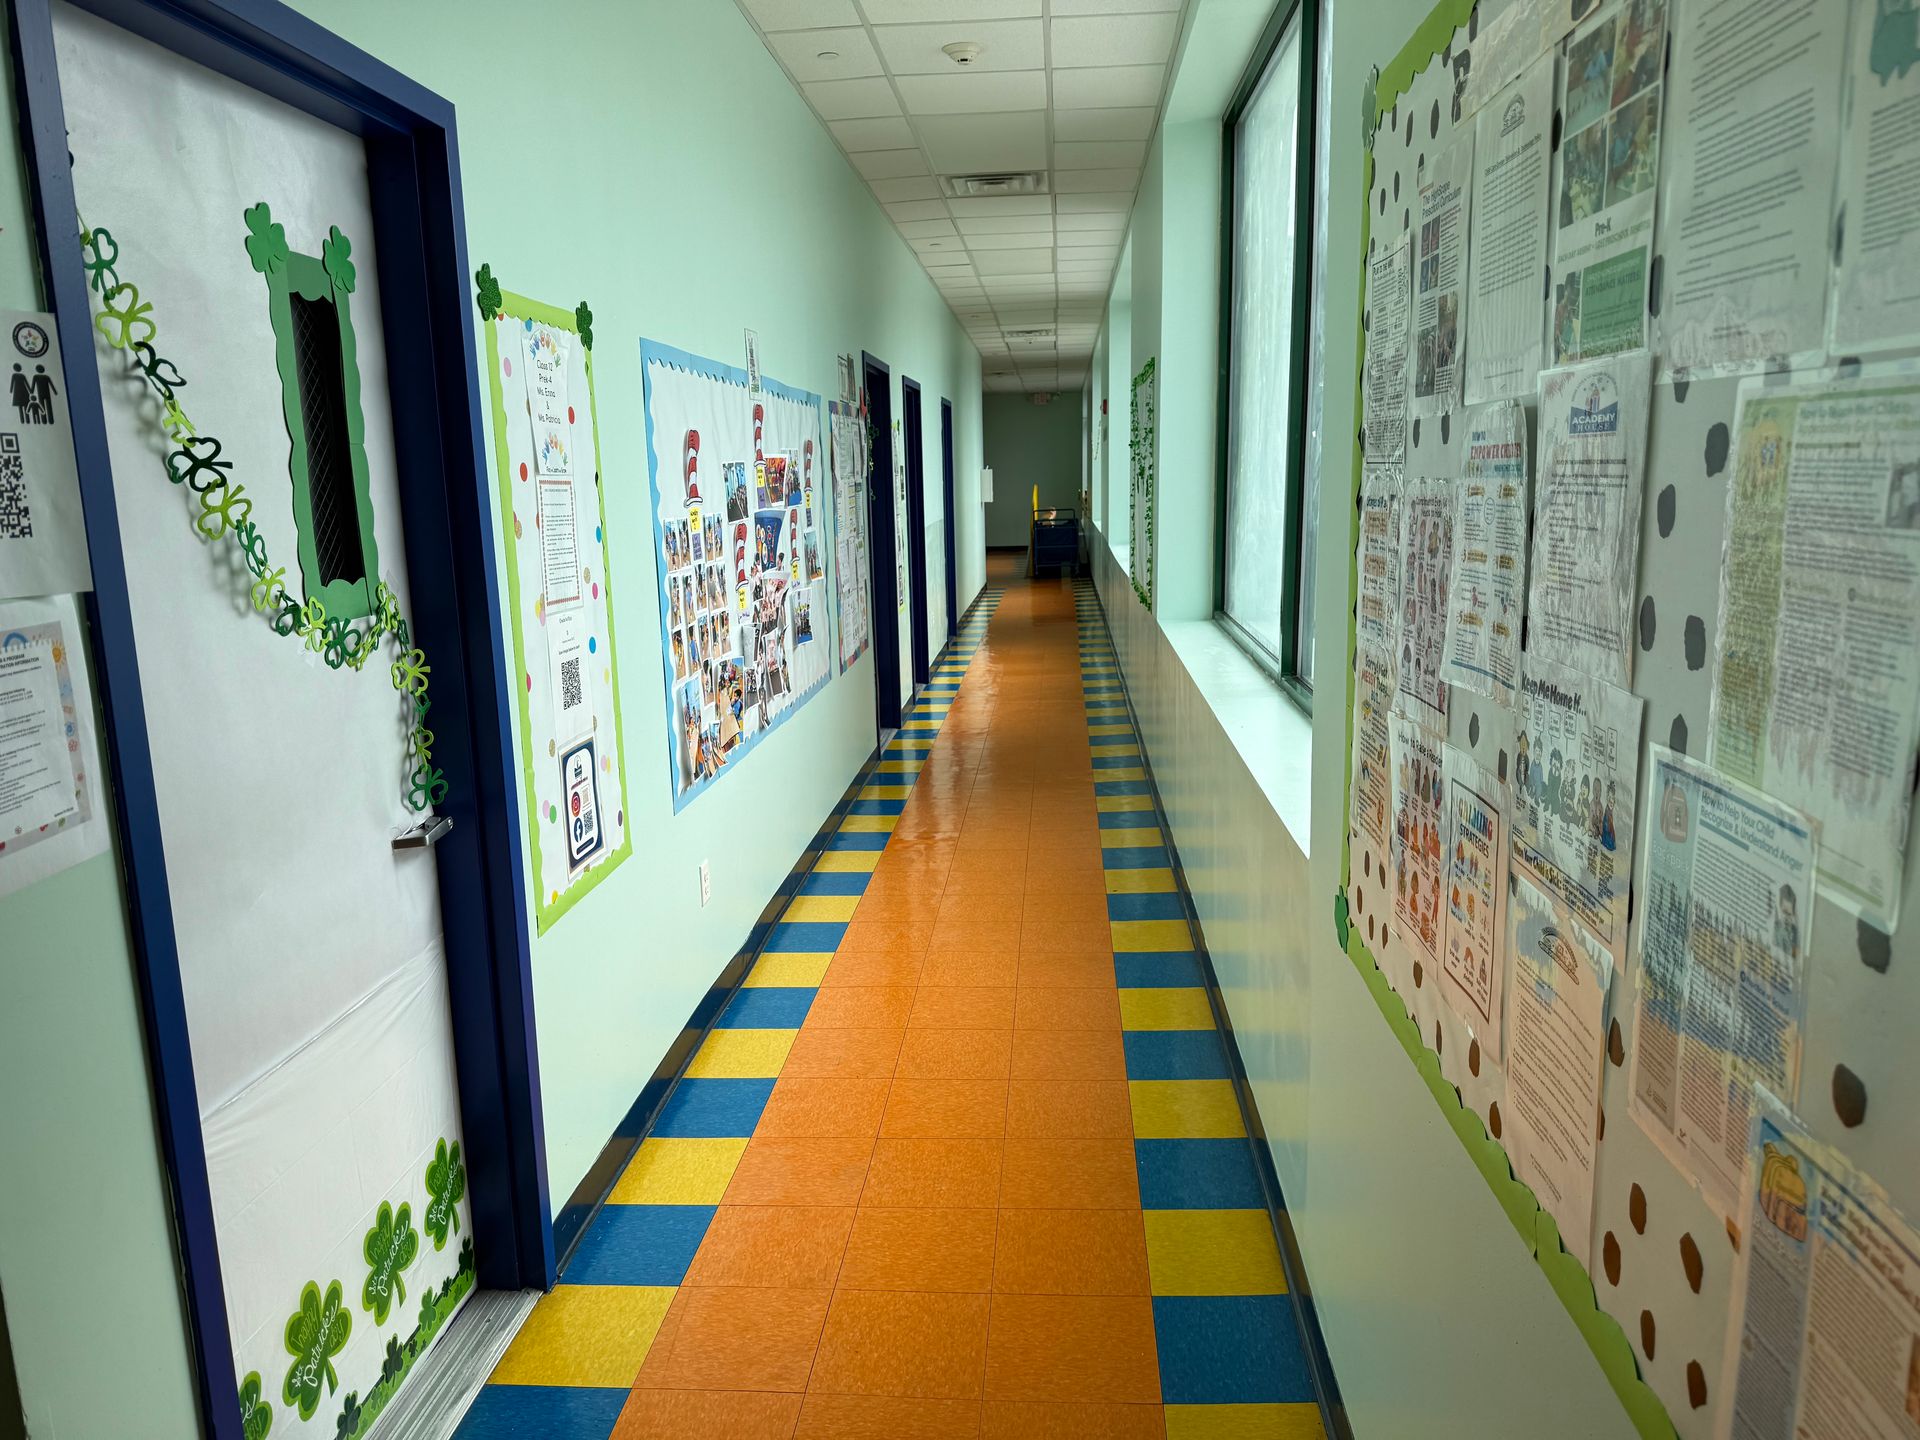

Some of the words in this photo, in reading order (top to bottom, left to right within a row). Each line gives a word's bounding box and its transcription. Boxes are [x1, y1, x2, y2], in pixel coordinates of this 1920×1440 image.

[1572, 413, 1616, 425] ACADEMY
[1522, 671, 1538, 702] Keep
[1538, 679, 1549, 700] Me
[1550, 684, 1573, 710] Home
[1398, 729, 1409, 745] How
[1701, 790, 1716, 808] How
[1717, 801, 1724, 812] to
[1724, 804, 1740, 821] Help
[1741, 811, 1756, 829] Your
[1756, 820, 1775, 840] Child
[1460, 823, 1489, 859] STRATEGIES
[1700, 805, 1733, 832] Recognize
[1740, 825, 1779, 859] Understand
[1780, 848, 1804, 872] Anger
[1533, 855, 1545, 877] Child
